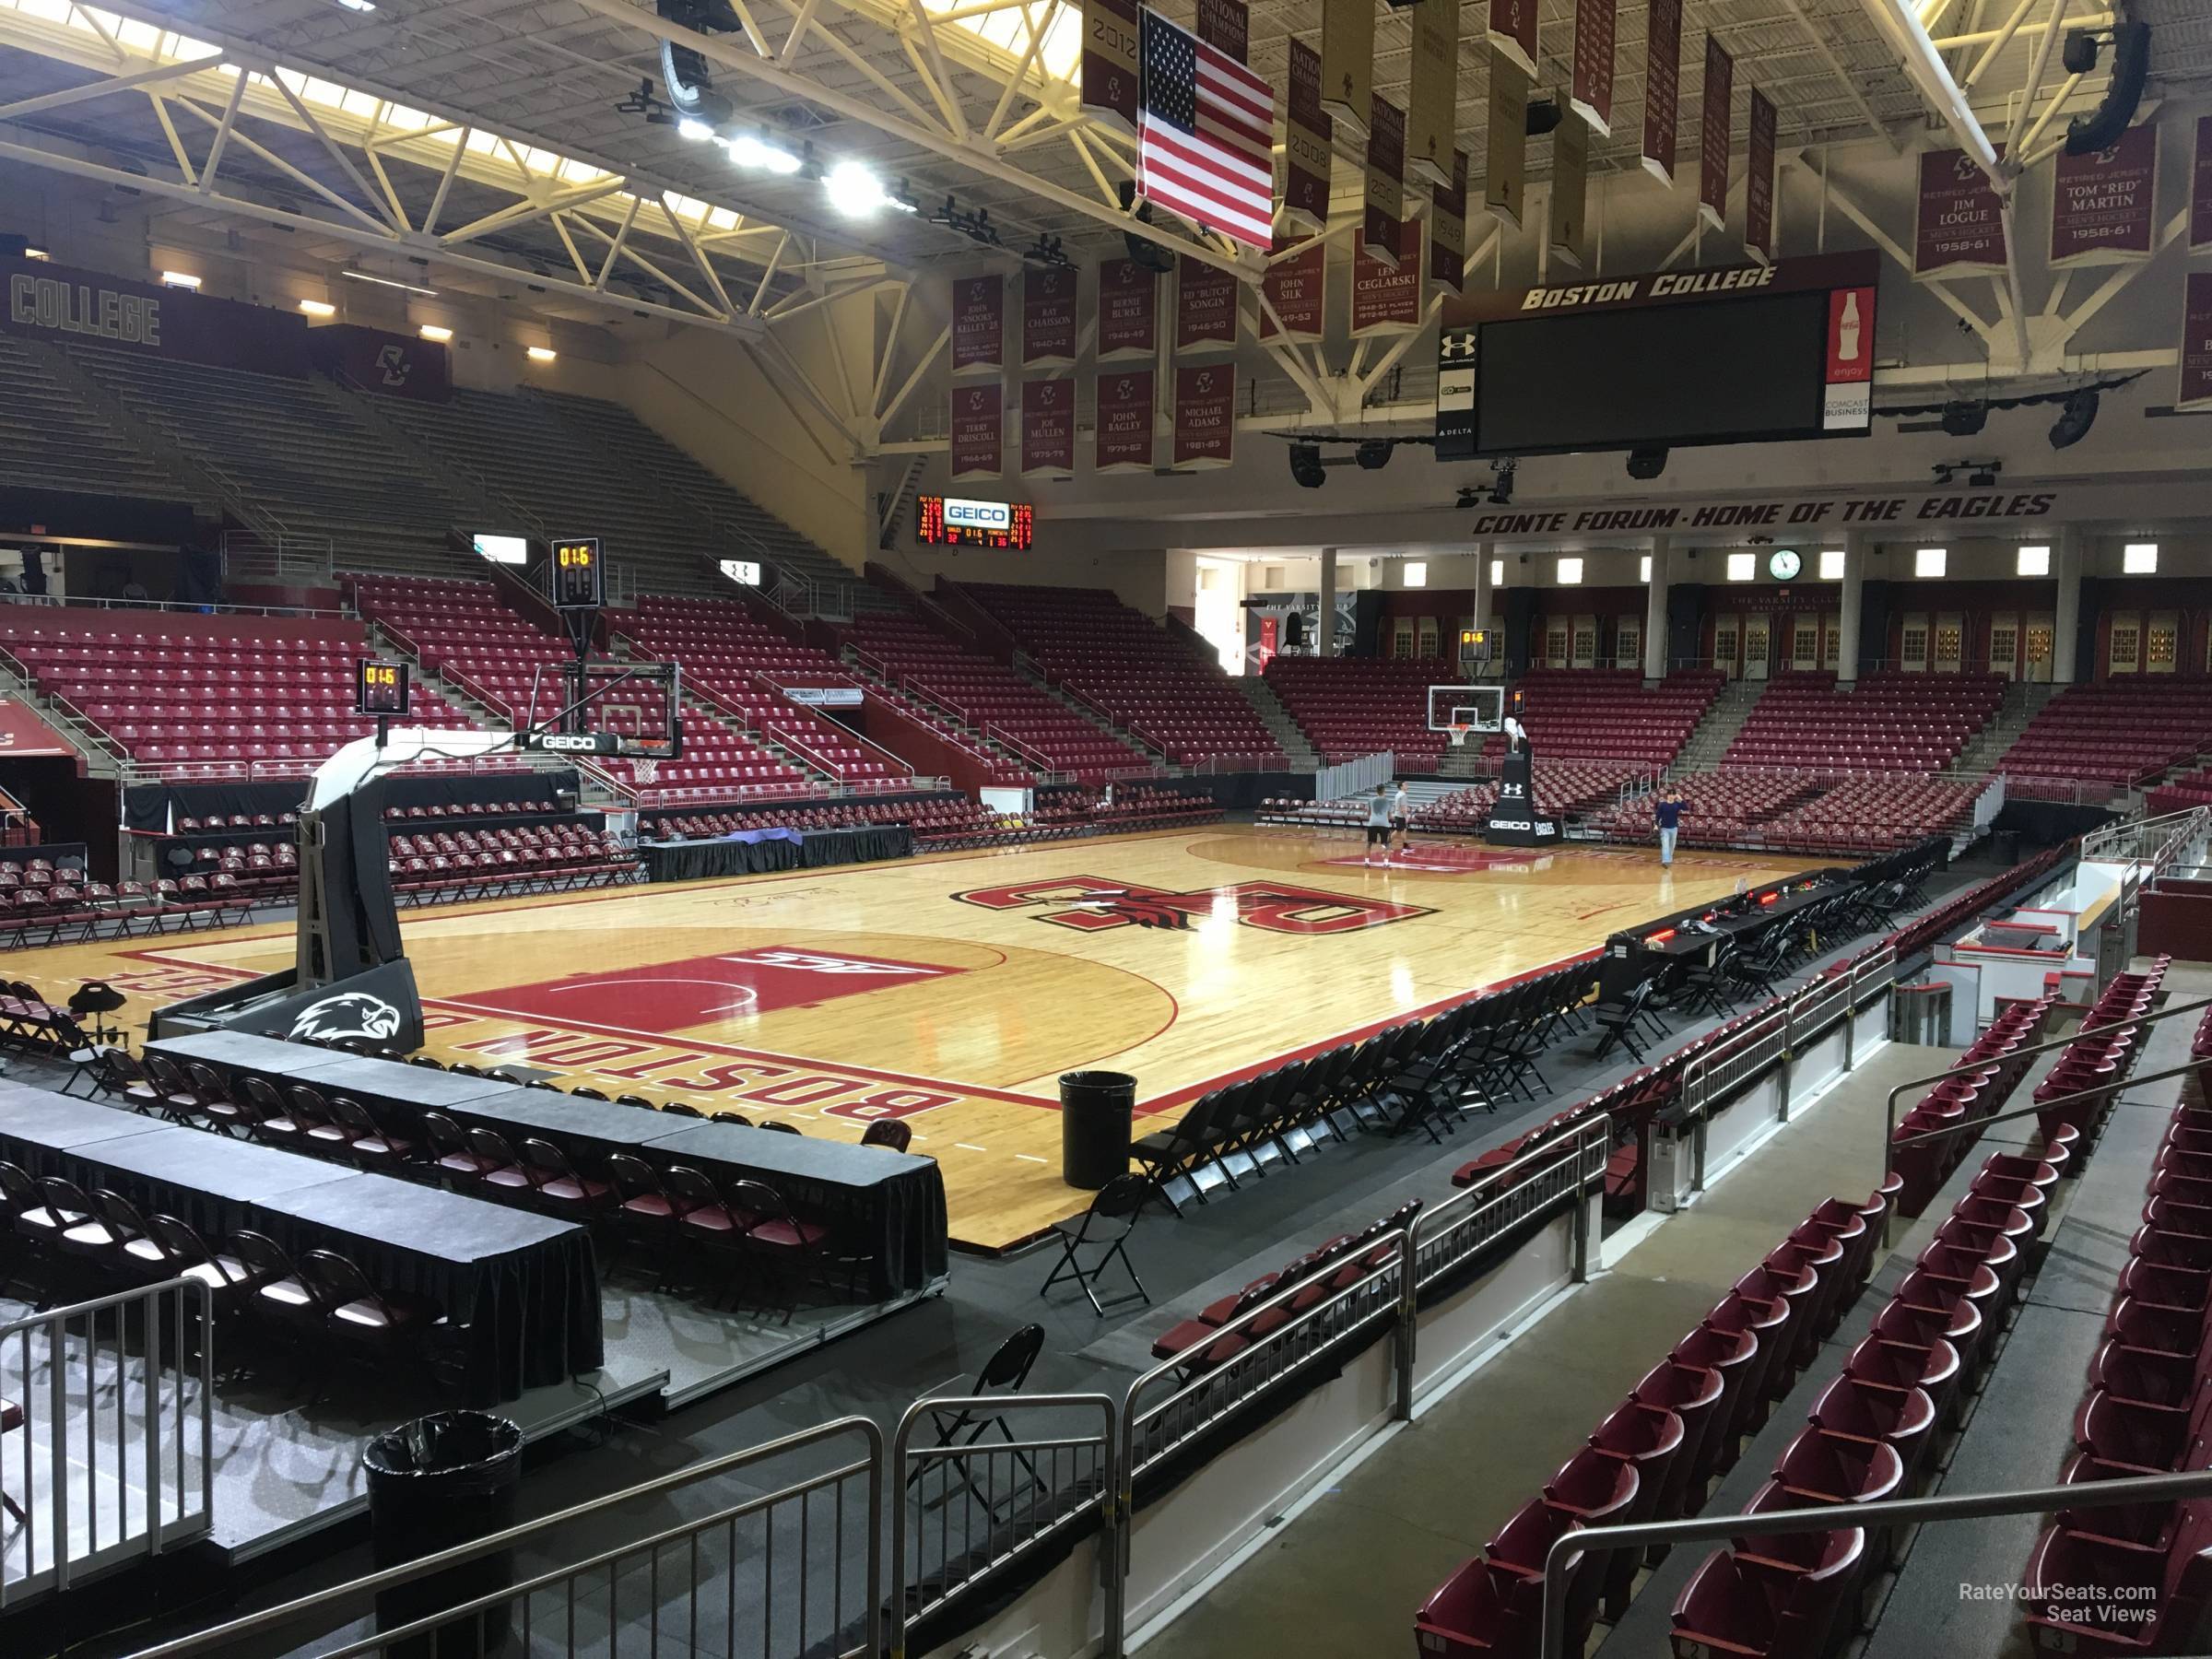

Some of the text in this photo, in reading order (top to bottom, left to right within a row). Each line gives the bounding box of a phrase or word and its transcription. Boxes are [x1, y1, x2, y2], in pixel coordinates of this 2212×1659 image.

[1200, 5, 1246, 42] CHAMPIONS
[1092, 18, 1136, 60] 2012
[1292, 134, 1327, 168] 2008
[2066, 184, 2098, 197] TOM
[1954, 199, 1975, 213] JIM
[2072, 194, 2135, 211] MARTIN
[1940, 209, 1989, 225] LOGUE
[1436, 218, 1462, 242] 1949
[2072, 225, 2131, 239] 1958-61
[1935, 239, 1990, 252] 1958-61
[1378, 268, 1395, 276] LEN
[1279, 278, 1304, 290] JOHN
[1358, 275, 1416, 290] CEGLARSKI
[1521, 265, 1777, 311] BOSTON COLLEGE
[1183, 291, 1195, 300] ED
[1280, 288, 1302, 300] SILK
[1113, 297, 1142, 309] BERNIE
[1189, 298, 1225, 311] SONGIN
[11, 273, 161, 347] COLLEGE
[1042, 308, 1058, 317] RAY
[1112, 307, 1142, 318] BURKE
[1028, 316, 1071, 328] CHAISSON
[1278, 312, 1312, 322] 49-53
[958, 323, 986, 333] KELLEY
[1834, 367, 1864, 377] enjoy
[1826, 399, 1868, 408] COMCAST
[1113, 412, 1136, 423] JOHN
[1185, 406, 1223, 418] MICHAEL
[1825, 407, 1868, 417] BUSINESS
[966, 424, 987, 433] TERRY
[1041, 419, 1054, 429] JOE
[1108, 420, 1142, 432] BAGLEY
[1188, 417, 1221, 428] ADAMS
[959, 432, 996, 443] DRISCOLL
[1030, 428, 1065, 438] MULLEN
[949, 506, 1006, 521] GEICO
[1474, 494, 2057, 535] CONTE FORUM HOME OF THE EAGLES
[367, 667, 394, 685] 01.6
[543, 735, 595, 750] GEICO
[1490, 820, 1531, 830] GEICO
[449, 1030, 968, 1123] BOSTON
[2053, 1630, 2065, 1649] 3
